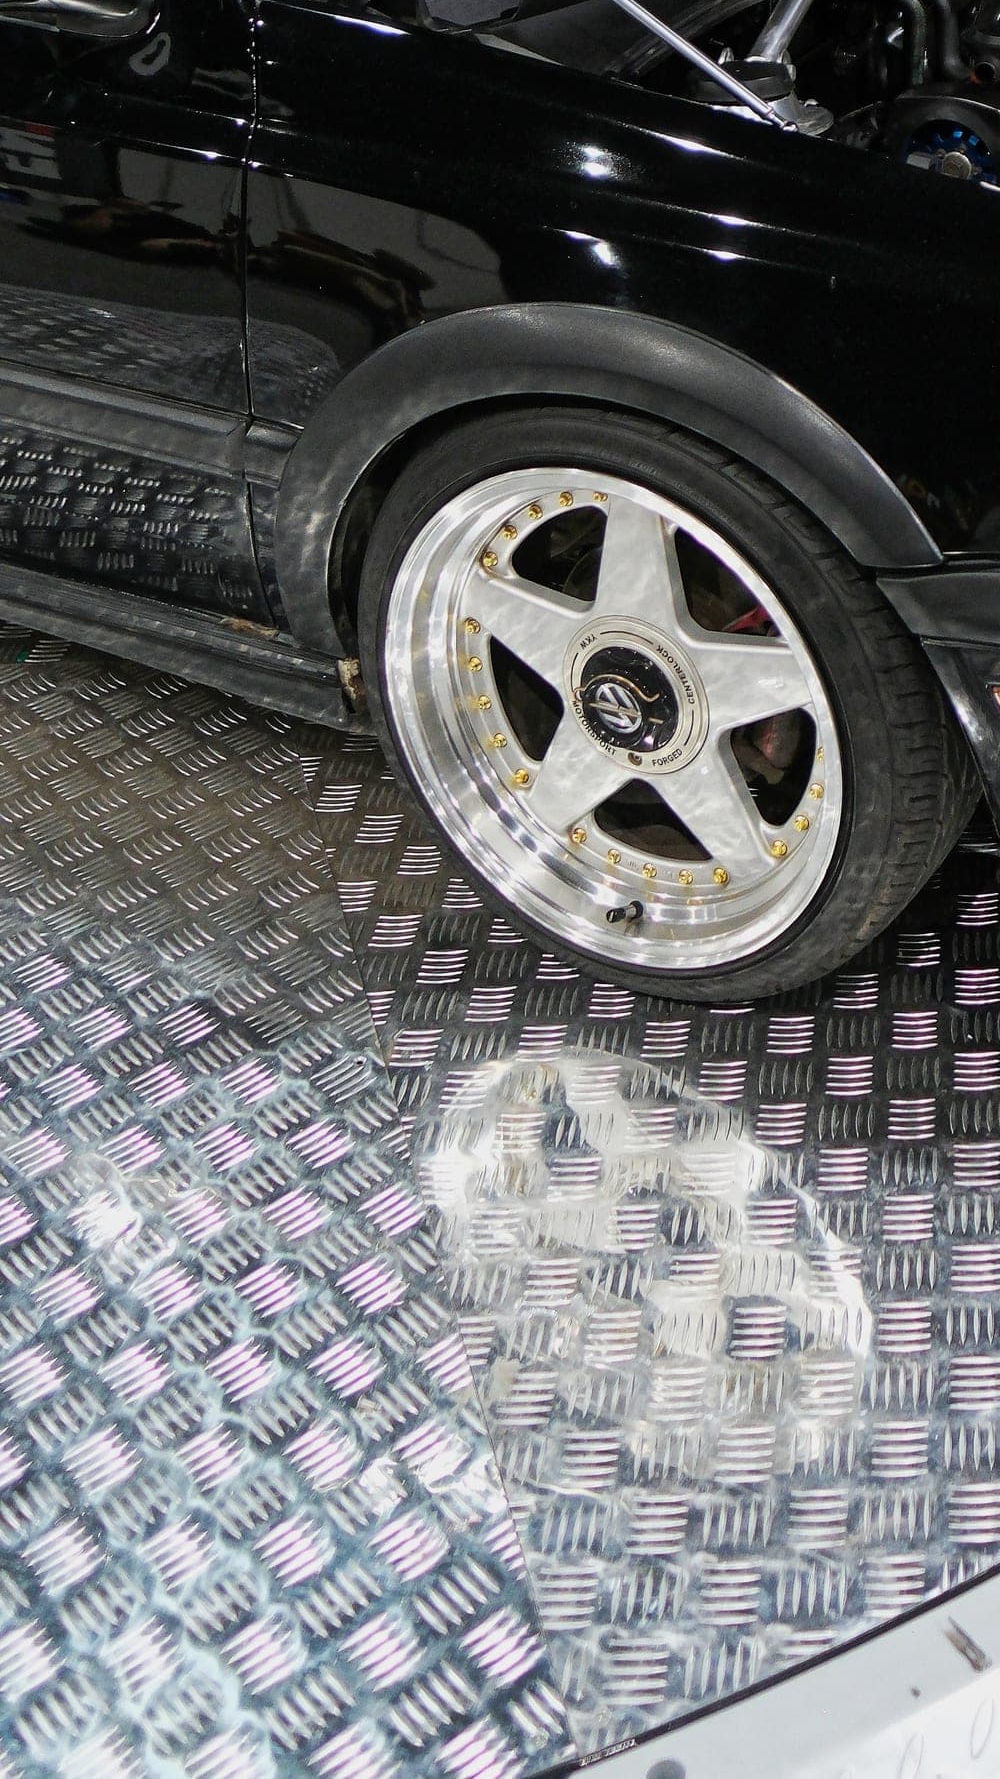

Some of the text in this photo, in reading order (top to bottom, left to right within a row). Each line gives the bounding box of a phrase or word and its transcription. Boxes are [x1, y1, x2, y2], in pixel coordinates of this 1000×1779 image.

[656, 644, 696, 705] CENTERLOCK
[571, 699, 617, 757] MOTORSPORT
[651, 747, 684, 768] FORGED
